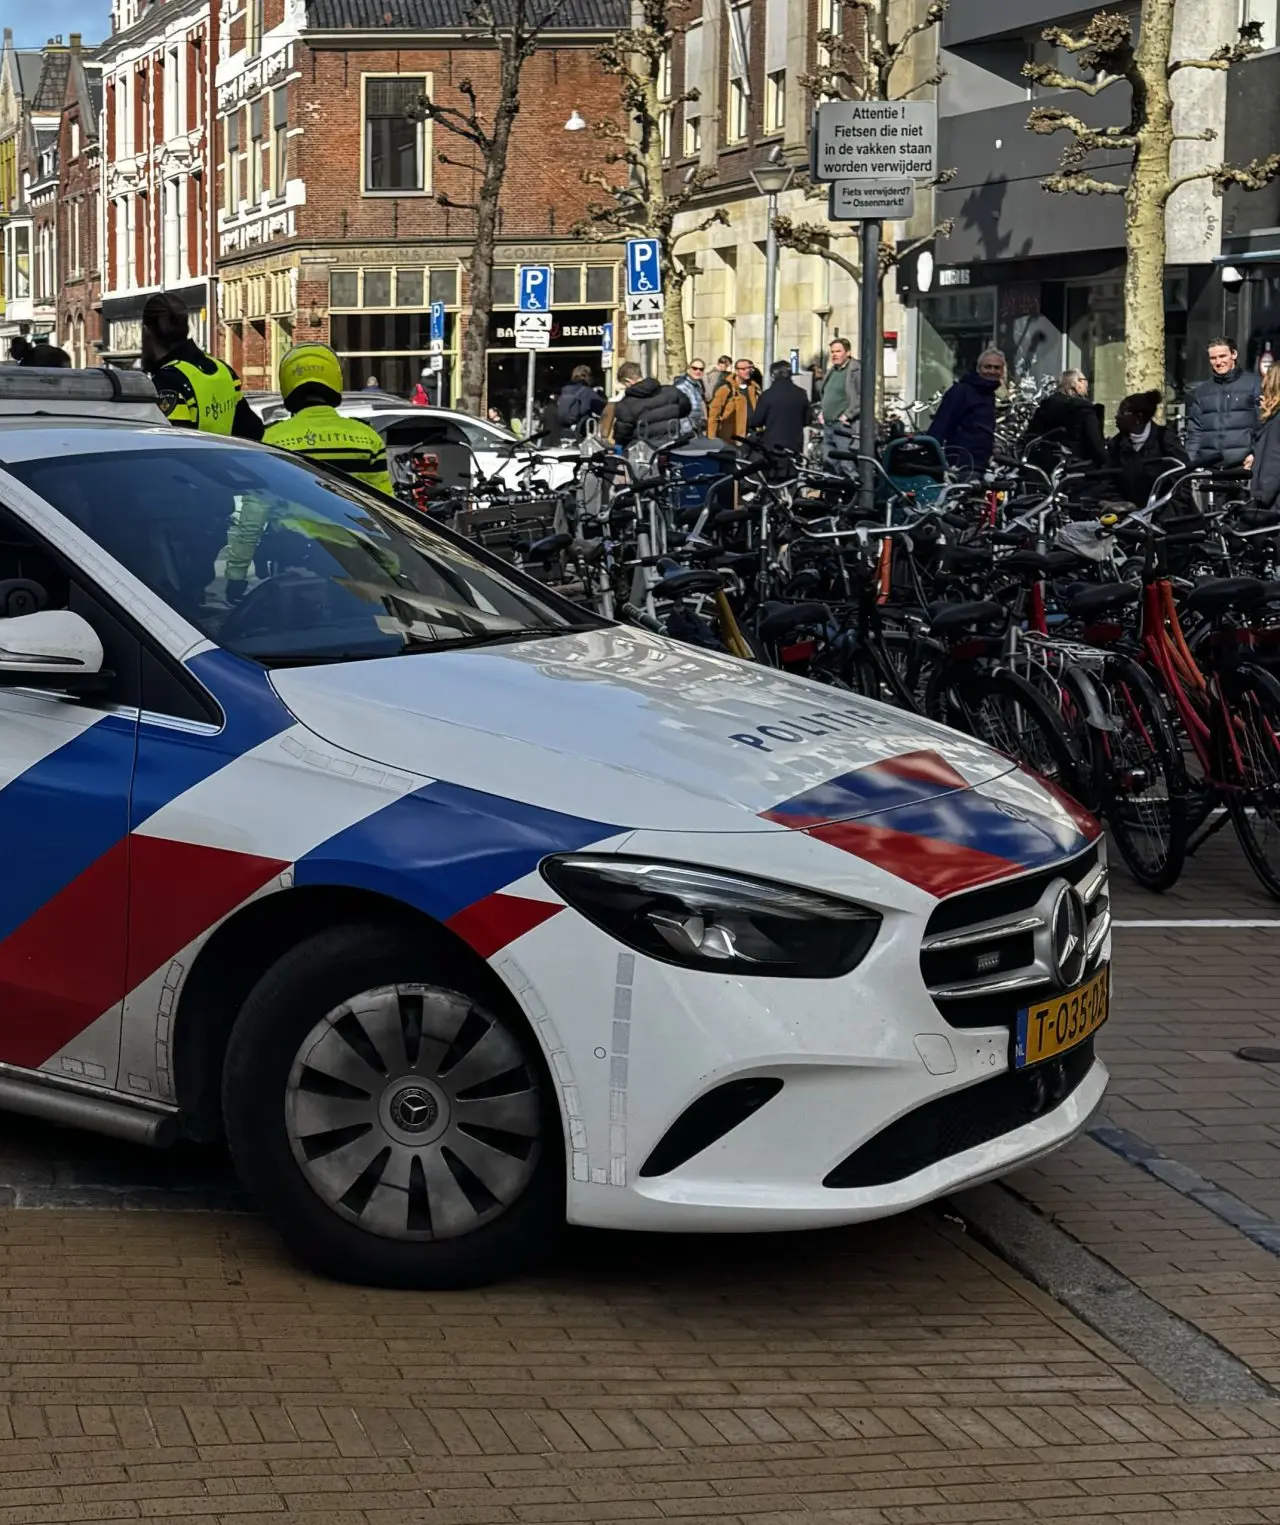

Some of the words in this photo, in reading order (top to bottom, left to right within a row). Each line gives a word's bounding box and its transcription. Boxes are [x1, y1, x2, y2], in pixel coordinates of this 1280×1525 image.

[852, 107, 898, 120] Attentie
[835, 125, 877, 137] Fietsen
[880, 125, 898, 137] die
[901, 124, 923, 136] niet
[825, 143, 835, 155] in
[838, 143, 853, 155] de
[856, 142, 896, 155] vakken
[899, 143, 932, 154] staan
[824, 160, 868, 173] worden
[871, 160, 932, 174] verwijderd
[842, 187, 861, 197] Fiets
[562, 325, 605, 336] BEANS
[728, 710, 890, 752] POLITIE
[1015, 1043, 1024, 1057] NL
